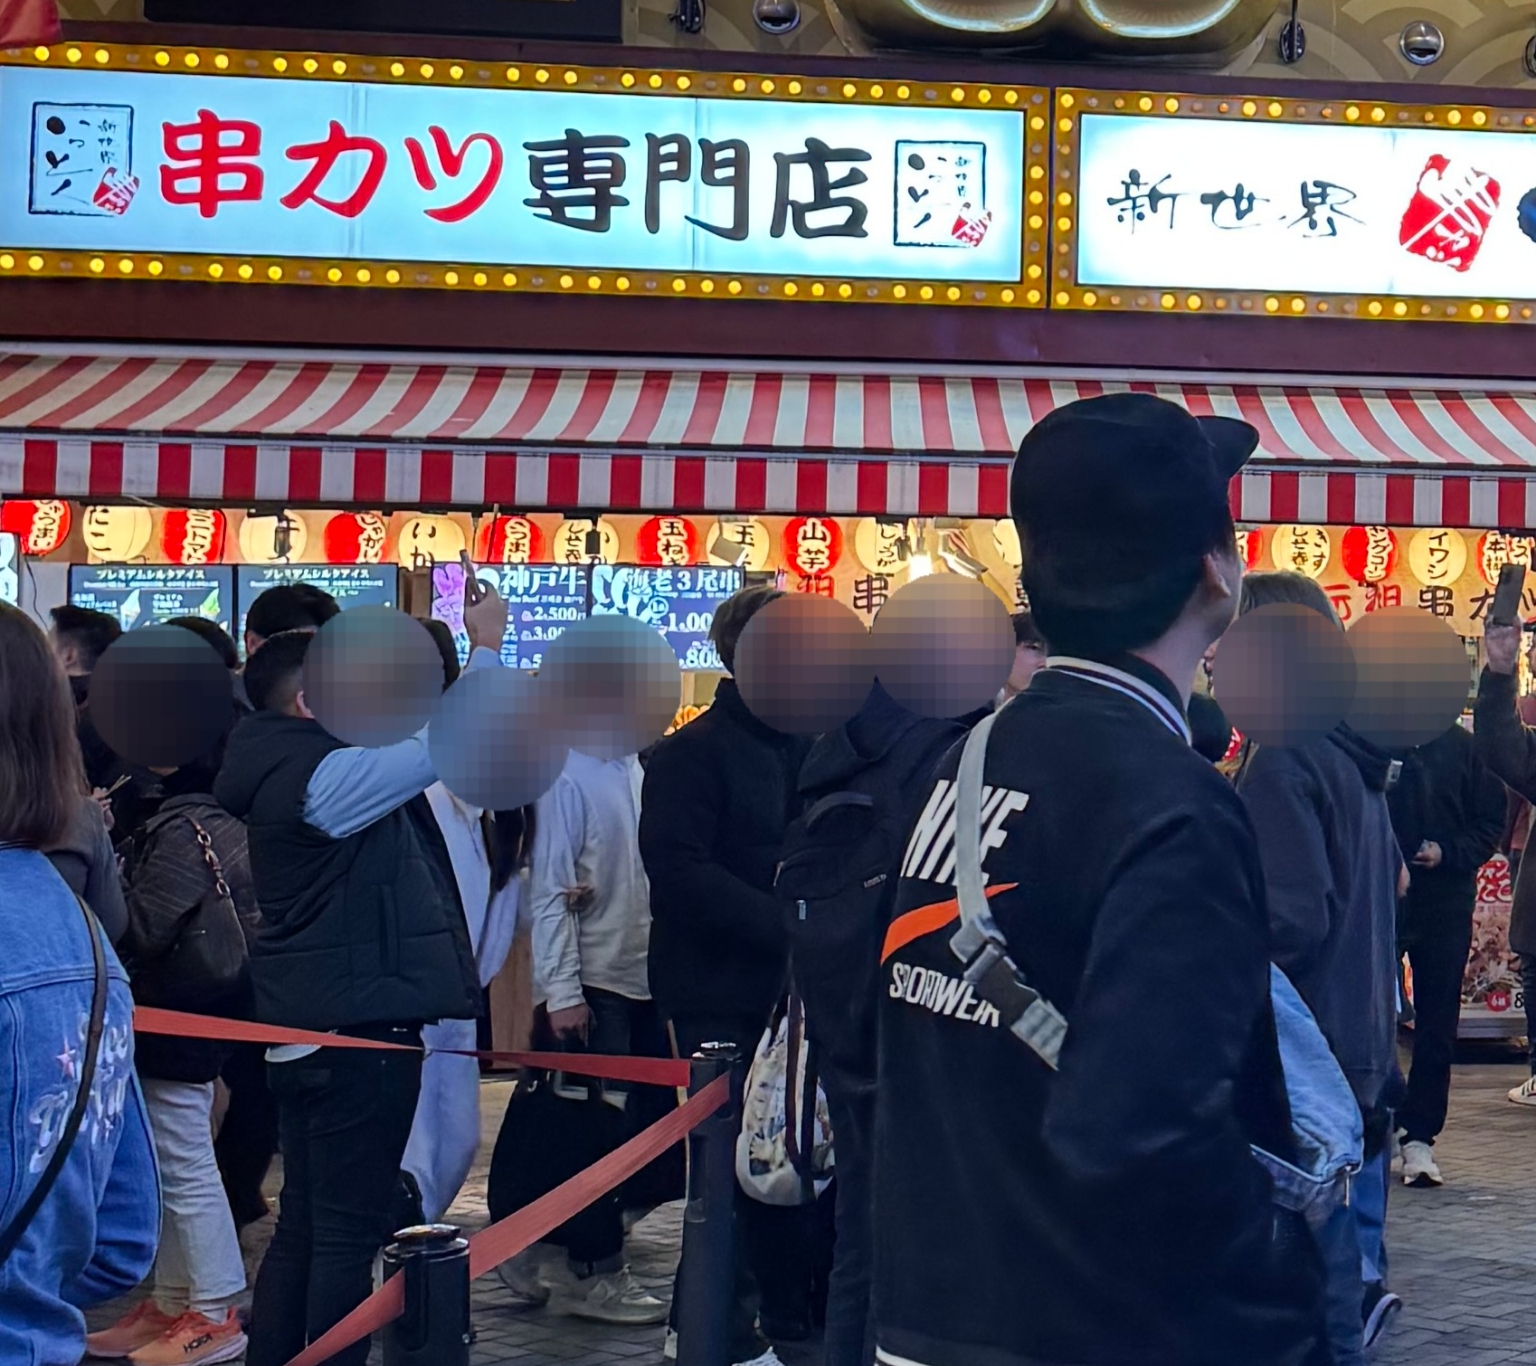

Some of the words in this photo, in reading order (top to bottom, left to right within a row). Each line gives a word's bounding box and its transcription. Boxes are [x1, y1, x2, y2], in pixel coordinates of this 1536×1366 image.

[159, 108, 869, 241] 串カツ専門店
[1107, 168, 1364, 238] 新世界
[411, 521, 437, 567] いか
[801, 521, 831, 569] 山芋
[1427, 531, 1451, 581] イワシ
[500, 565, 587, 595] 神戸牛
